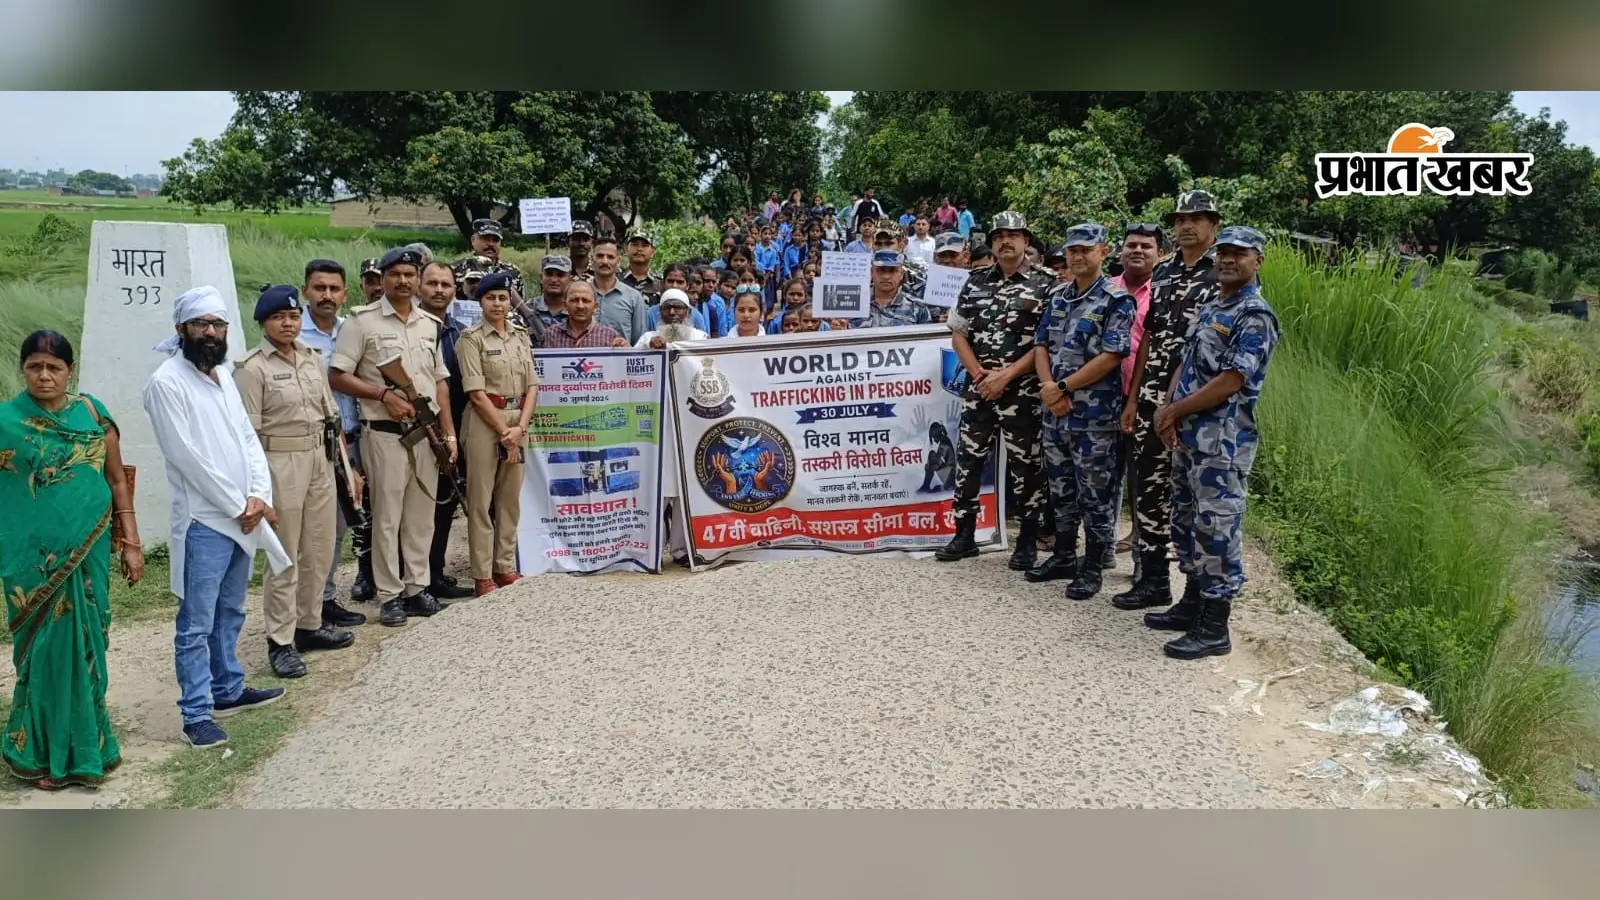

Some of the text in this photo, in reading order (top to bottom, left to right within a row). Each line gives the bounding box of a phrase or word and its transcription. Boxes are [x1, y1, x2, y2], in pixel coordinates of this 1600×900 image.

[111, 248, 166, 278] भारत
[121, 285, 161, 305] 393
[626, 358, 646, 366] JUST
[626, 364, 655, 373] RIGHTS
[763, 347, 915, 376] WORLD DAY
[561, 372, 604, 380] PRAYAS
[815, 372, 872, 385] AGAINST
[599, 379, 626, 391] विरोधी
[628, 379, 653, 389] दिवस
[700, 380, 719, 394] SSB
[570, 394, 589, 404] जुलाई
[751, 379, 932, 408] TRAFFICKING IN PERSONS
[820, 405, 871, 418] 30 JULY
[803, 428, 891, 449] विश्व मानव
[801, 446, 923, 473] तस्करी विरोधी दिवस
[556, 499, 628, 516] सावधान
[702, 518, 747, 544] 47वीं
[749, 514, 806, 538] वाहिनी,
[807, 519, 860, 537] सशस्त्र
[862, 512, 904, 535] सीमा
[907, 511, 940, 532] बल,
[546, 549, 571, 558] 1098
